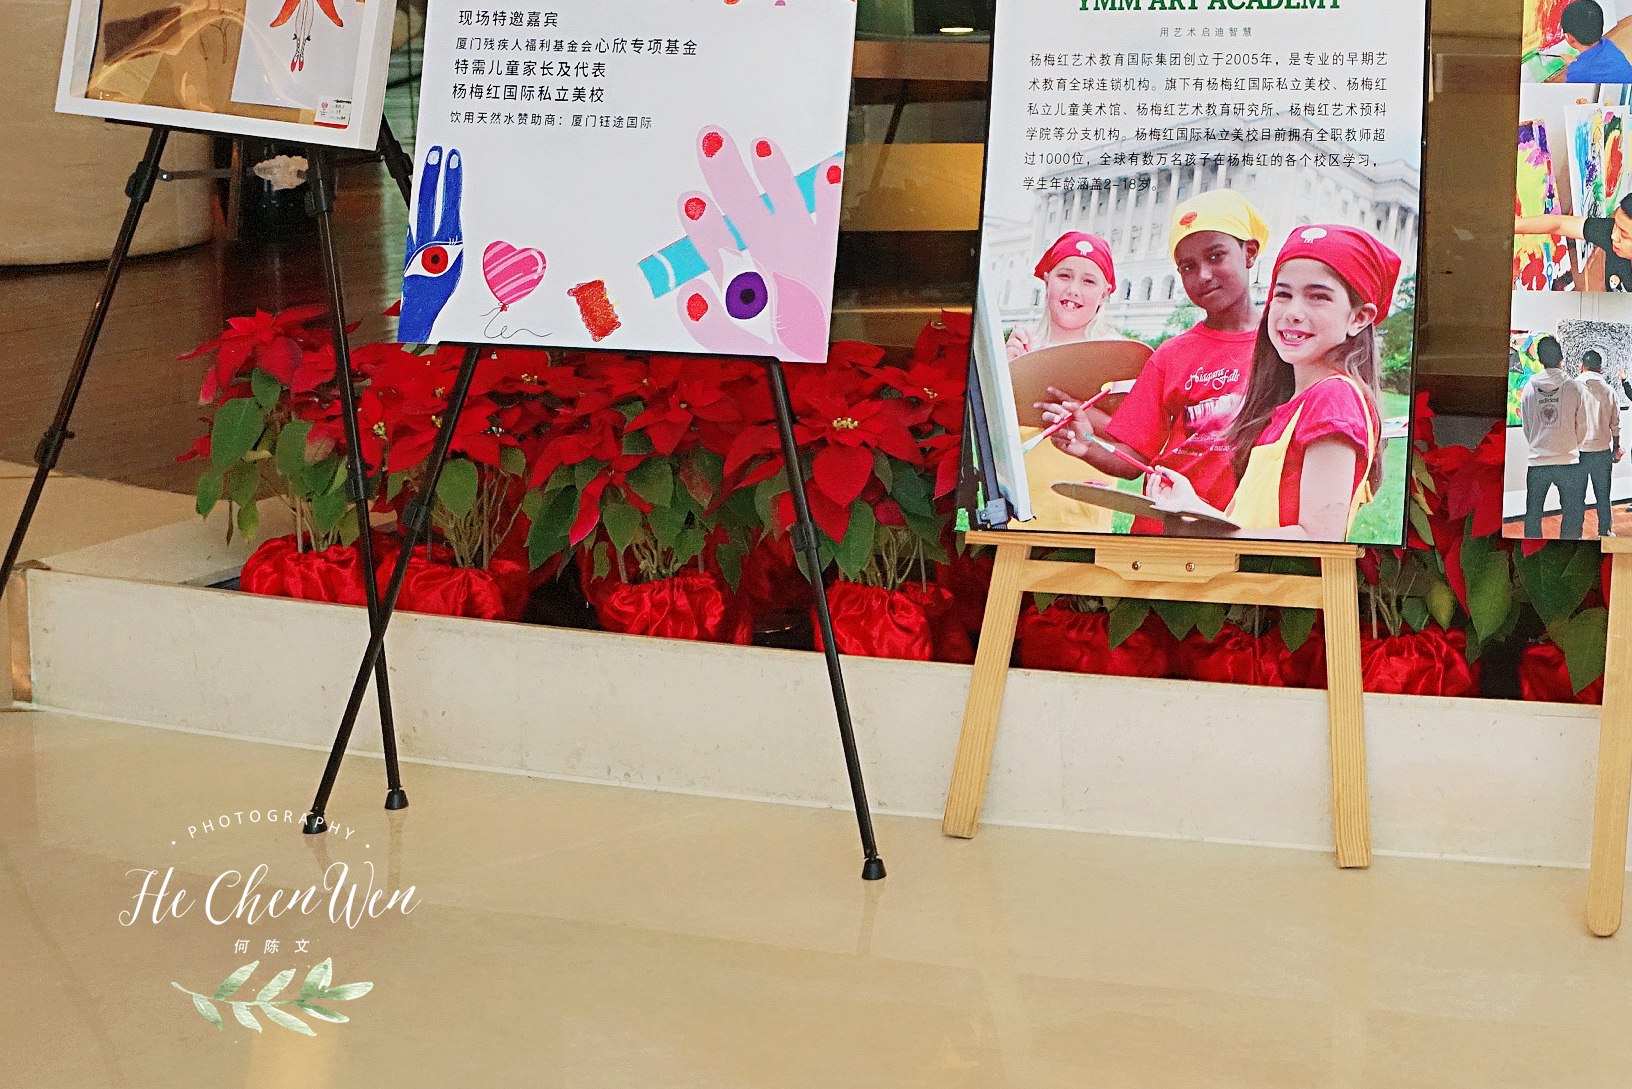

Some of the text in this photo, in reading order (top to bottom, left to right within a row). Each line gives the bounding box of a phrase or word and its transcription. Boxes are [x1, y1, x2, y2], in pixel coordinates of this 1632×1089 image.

[458, 10, 559, 28] 现场特邀嘉宾
[1159, 26, 1254, 38] 用艺术启迪智慧
[455, 37, 698, 56] 厦门残疾人福利基金会心欣专项基金
[1030, 51, 1388, 67] 杨梅红艺术教育国际集团创立于2005年，是专业的早期艺
[454, 59, 606, 79] 特需儿童家长及代表
[1029, 76, 1388, 92] 术教育全球连锁机构。旗下有杨梅红国际私立美校、杨梅红
[452, 84, 605, 104] 杨梅红国际私立美校
[1027, 101, 1387, 118] 私立儿童美术馆、杨梅红艺术教育研究所、杨梅红艺术预科
[1026, 126, 1385, 142] 学院等分支机构。杨梅红国际私立美校目前拥有全职教师超
[1024, 152, 1377, 168] 过1000位，全球有数万名孩子在杨梅红的各个校区学习，
[1023, 177, 1158, 192] 学生年龄涵盖2-18岁。
